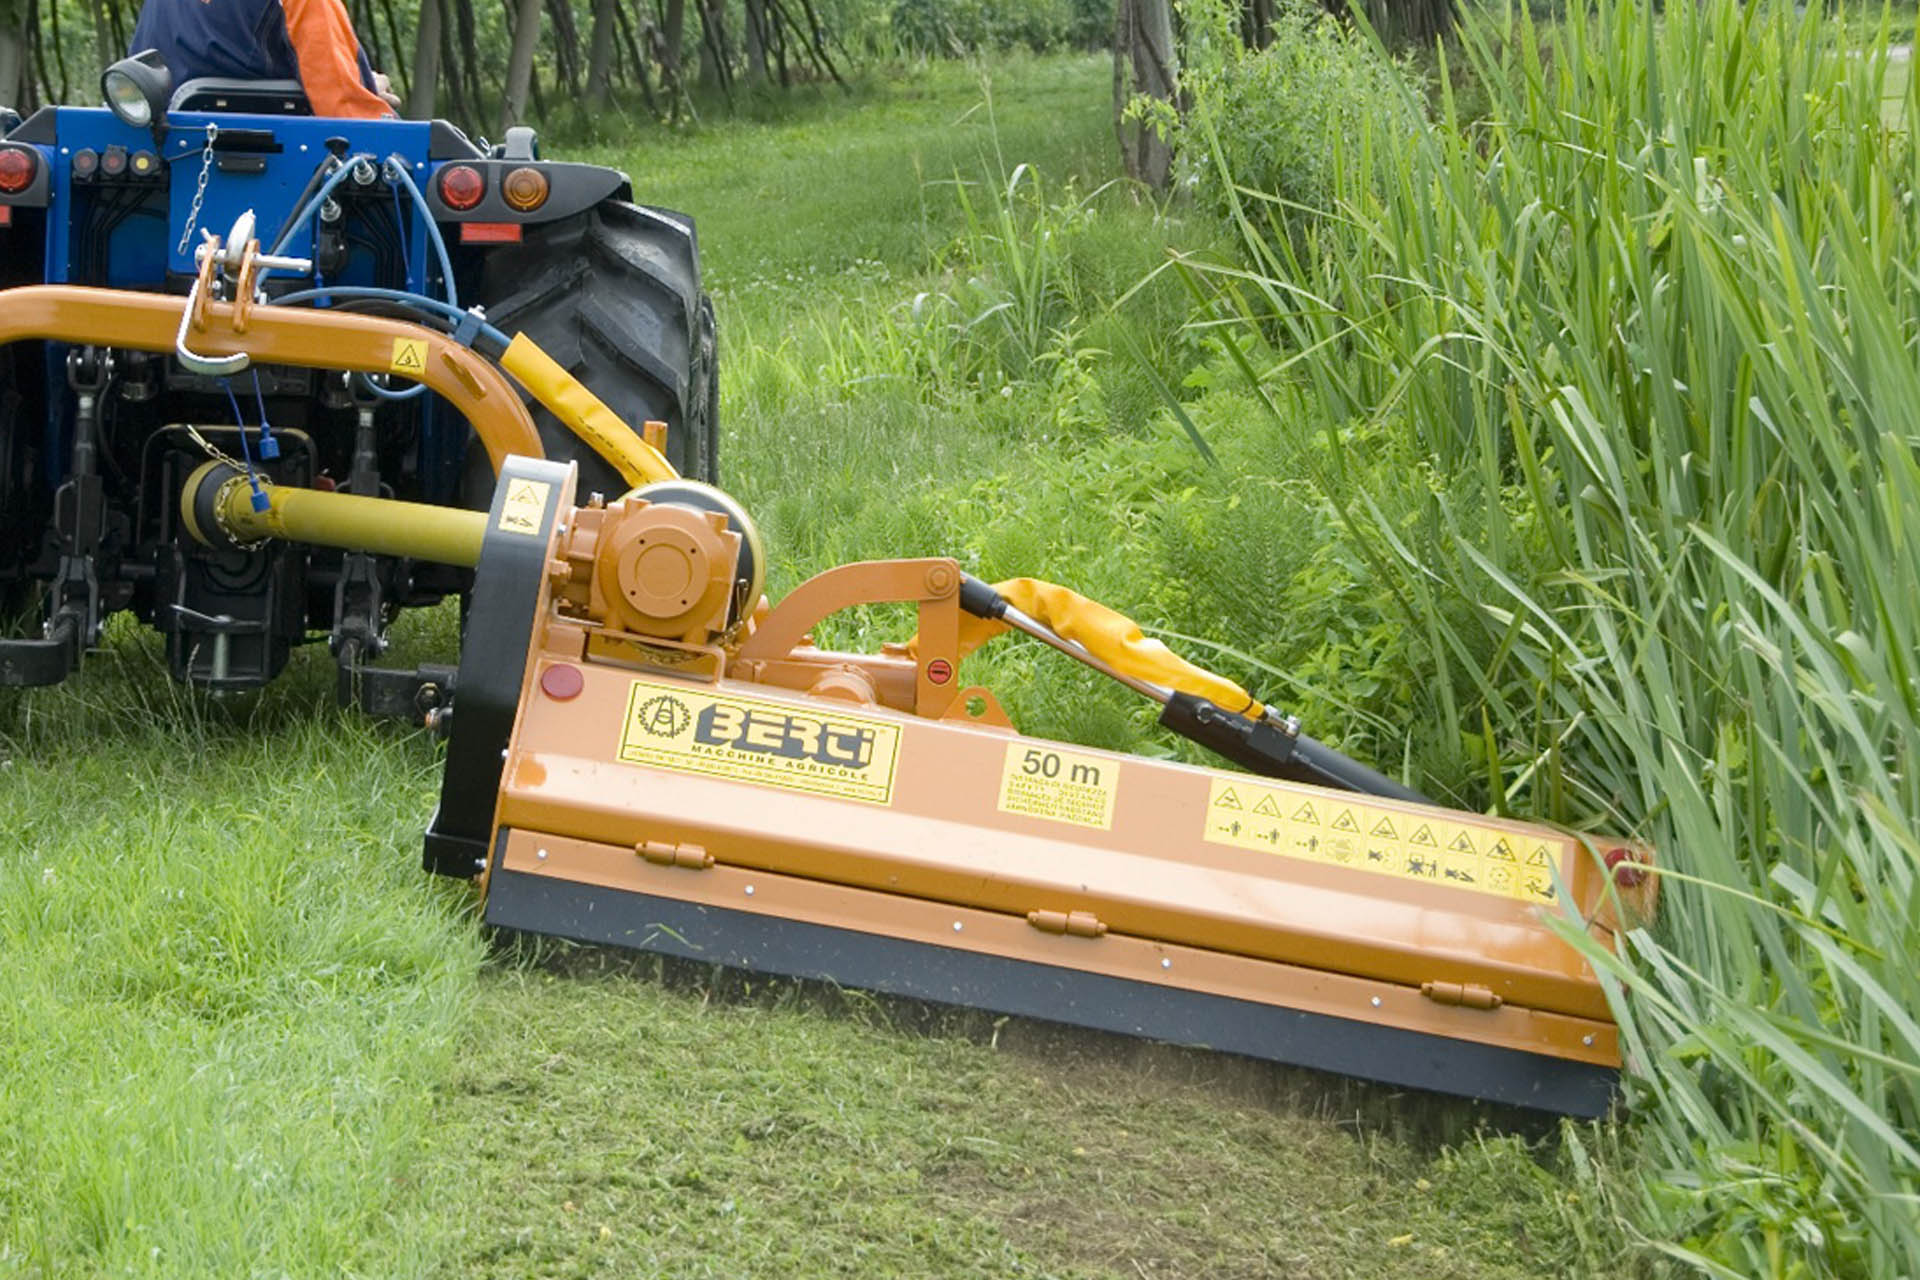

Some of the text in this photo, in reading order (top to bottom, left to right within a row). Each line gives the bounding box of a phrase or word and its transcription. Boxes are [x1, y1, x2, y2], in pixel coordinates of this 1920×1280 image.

[692, 745, 776, 766] MACCHINE
[785, 761, 870, 782] AGRICOLE
[1023, 750, 1101, 786] 50 m
